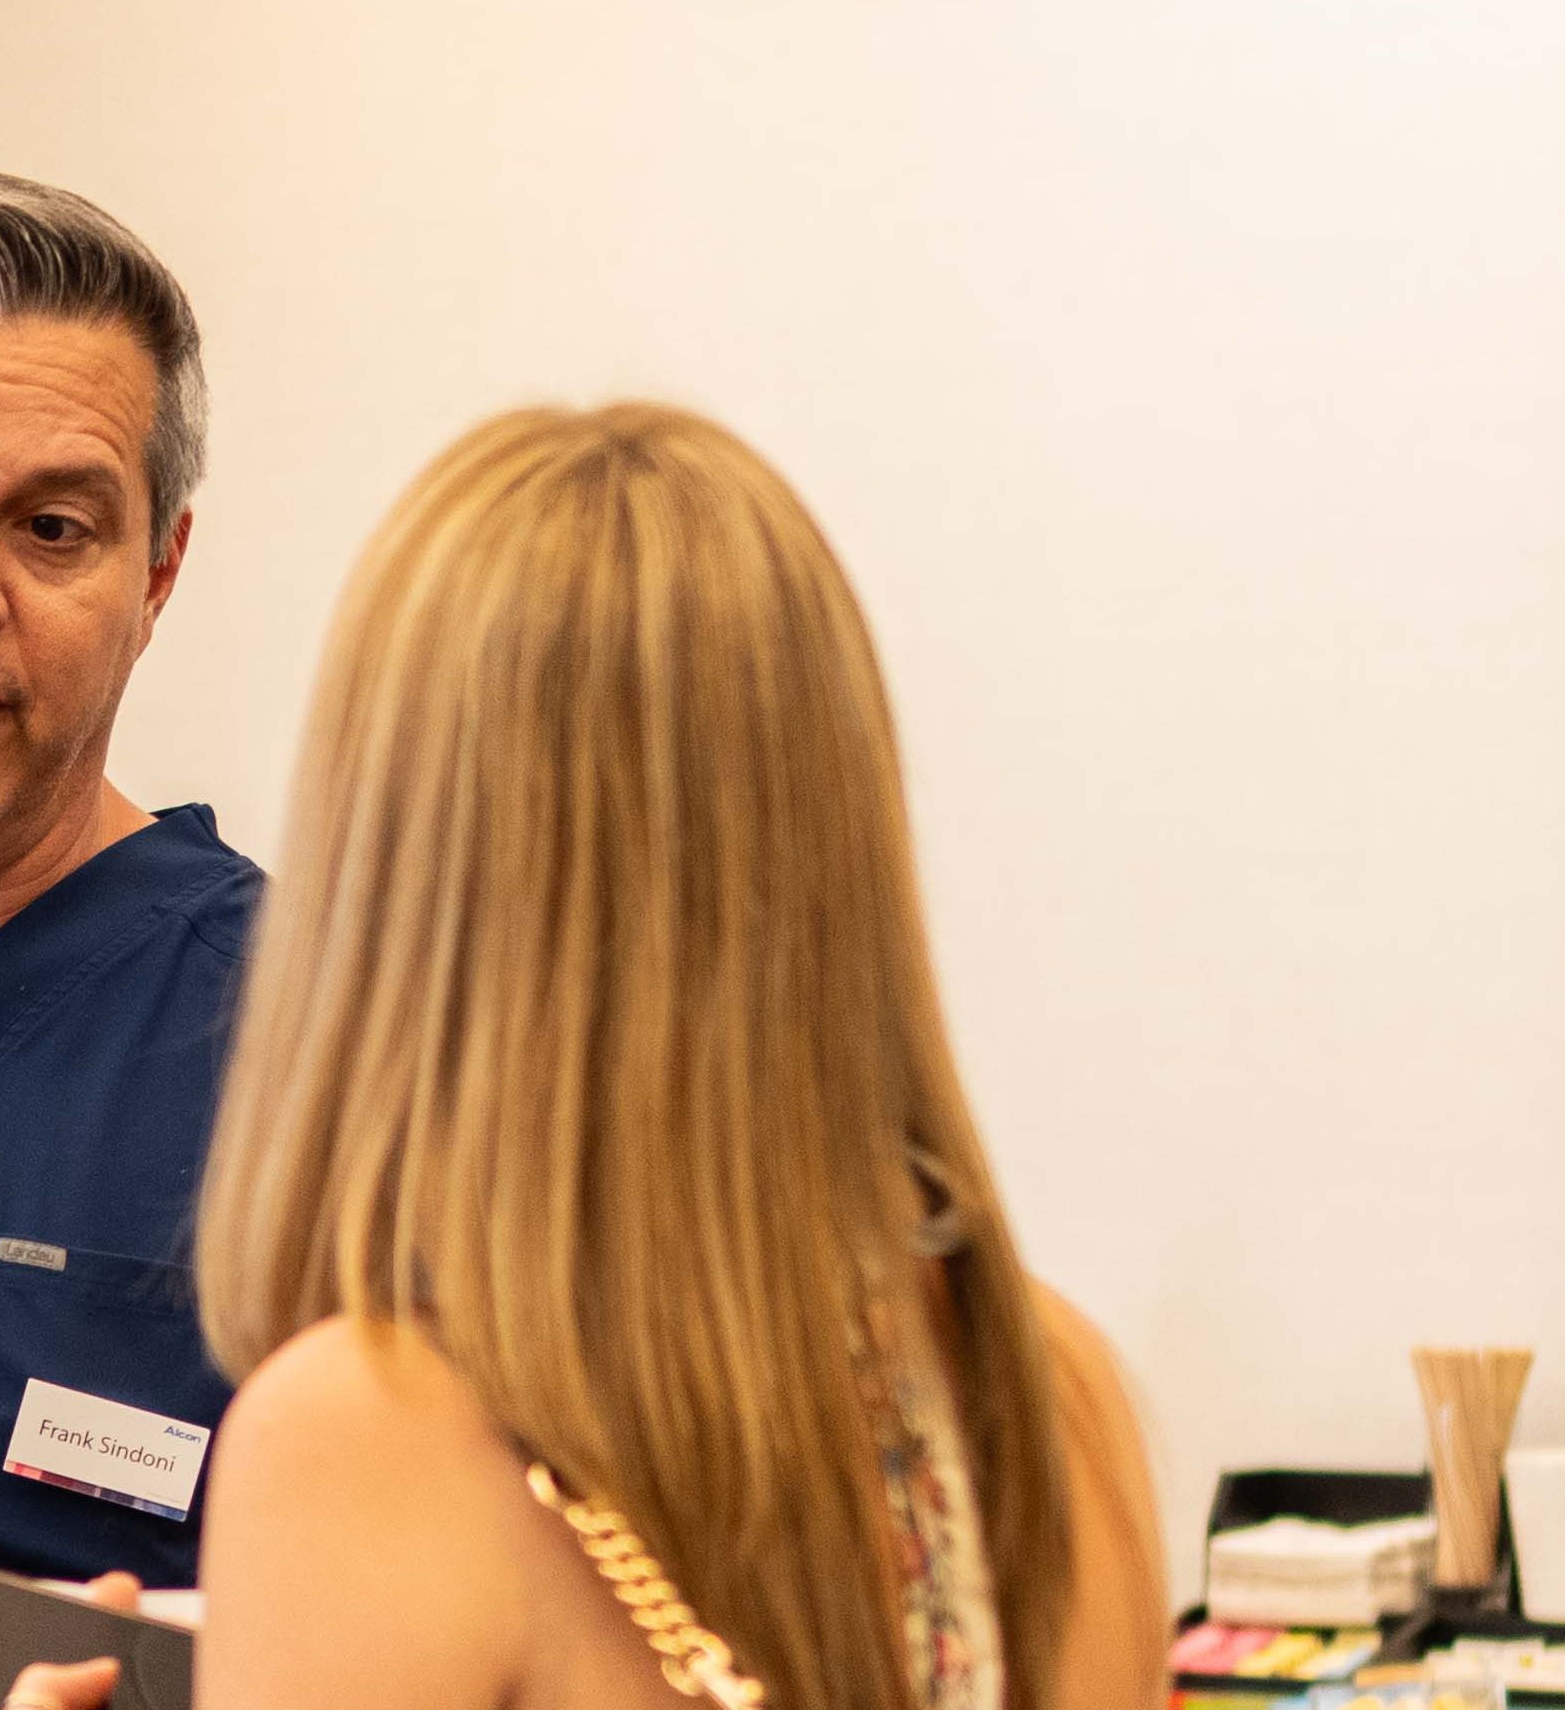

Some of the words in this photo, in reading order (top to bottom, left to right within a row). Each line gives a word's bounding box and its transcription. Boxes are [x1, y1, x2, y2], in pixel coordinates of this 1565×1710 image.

[38, 1418, 94, 1451] Frank
[98, 1436, 177, 1474] Sindoni
[164, 1425, 202, 1445] Alcon
